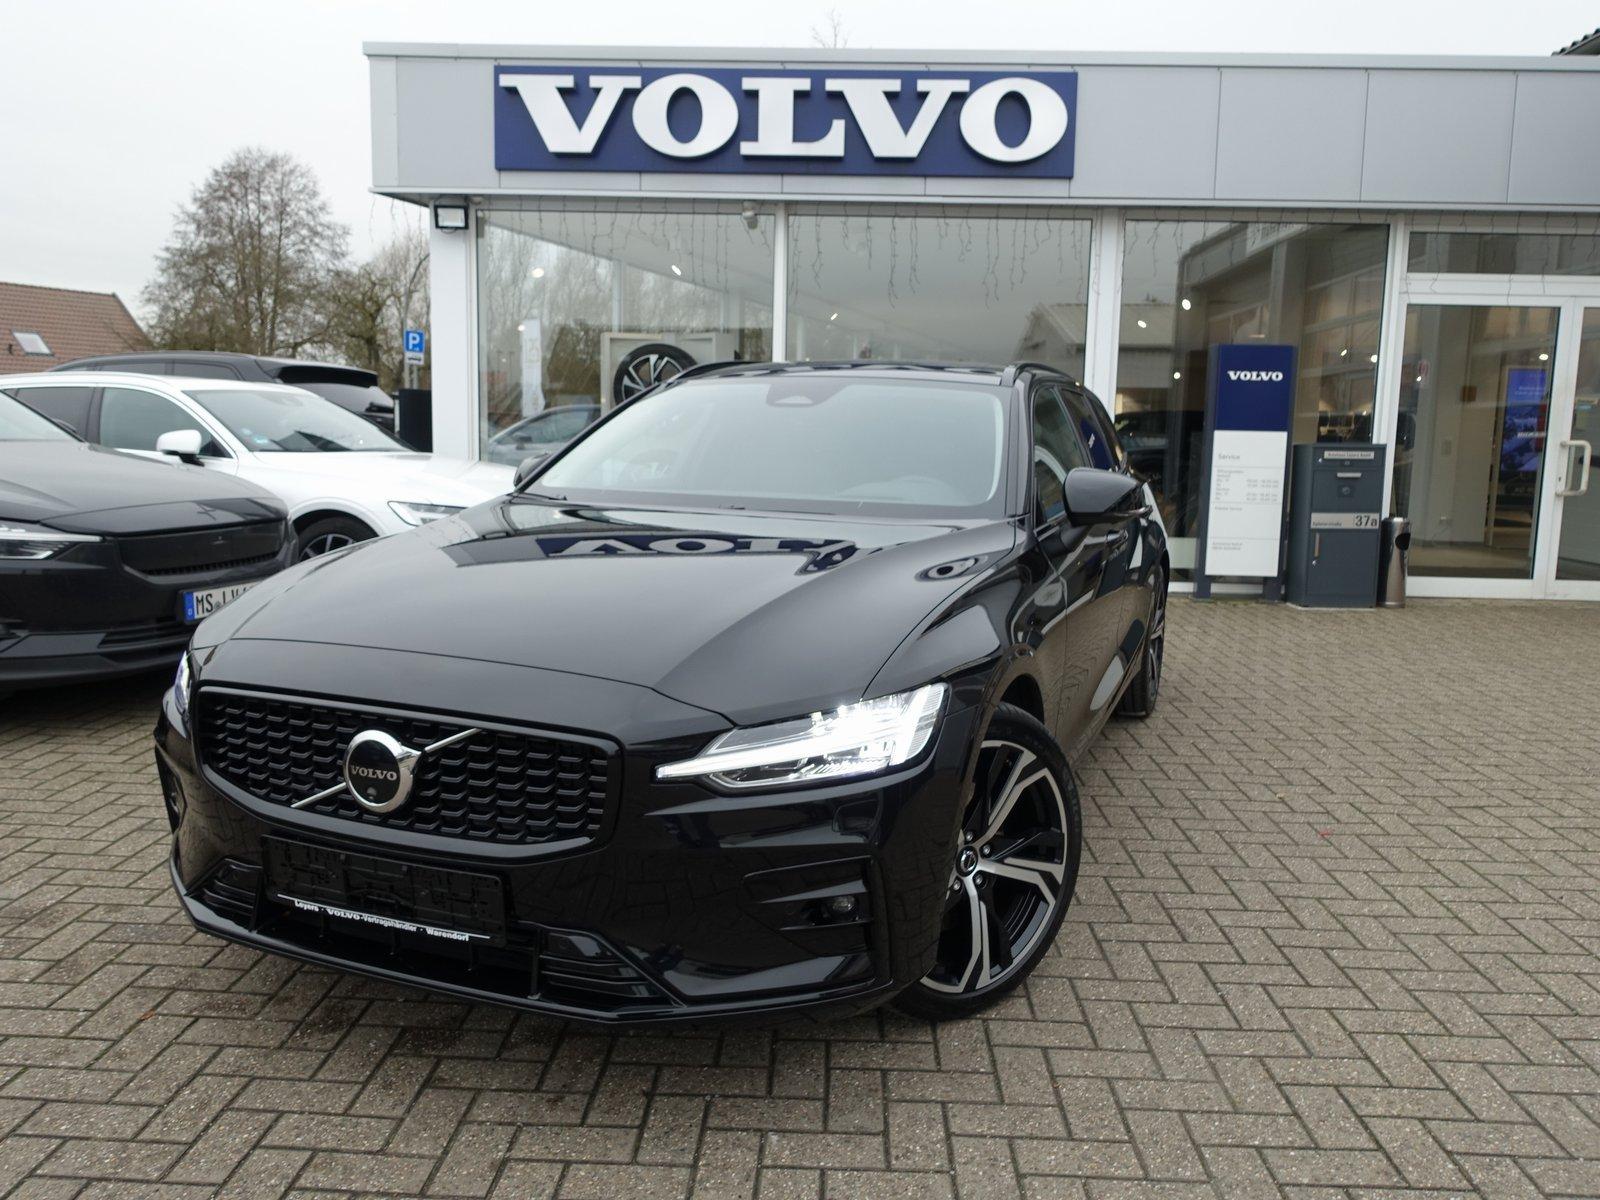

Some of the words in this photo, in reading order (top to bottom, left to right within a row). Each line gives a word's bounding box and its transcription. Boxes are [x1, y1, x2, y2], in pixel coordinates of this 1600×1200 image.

[499, 73, 1068, 162] VOLVO
[409, 333, 420, 349] P
[1227, 370, 1283, 382] VOLVO
[1355, 515, 1377, 527] 37a
[196, 593, 213, 614] MS
[351, 765, 397, 781] VOLVO
